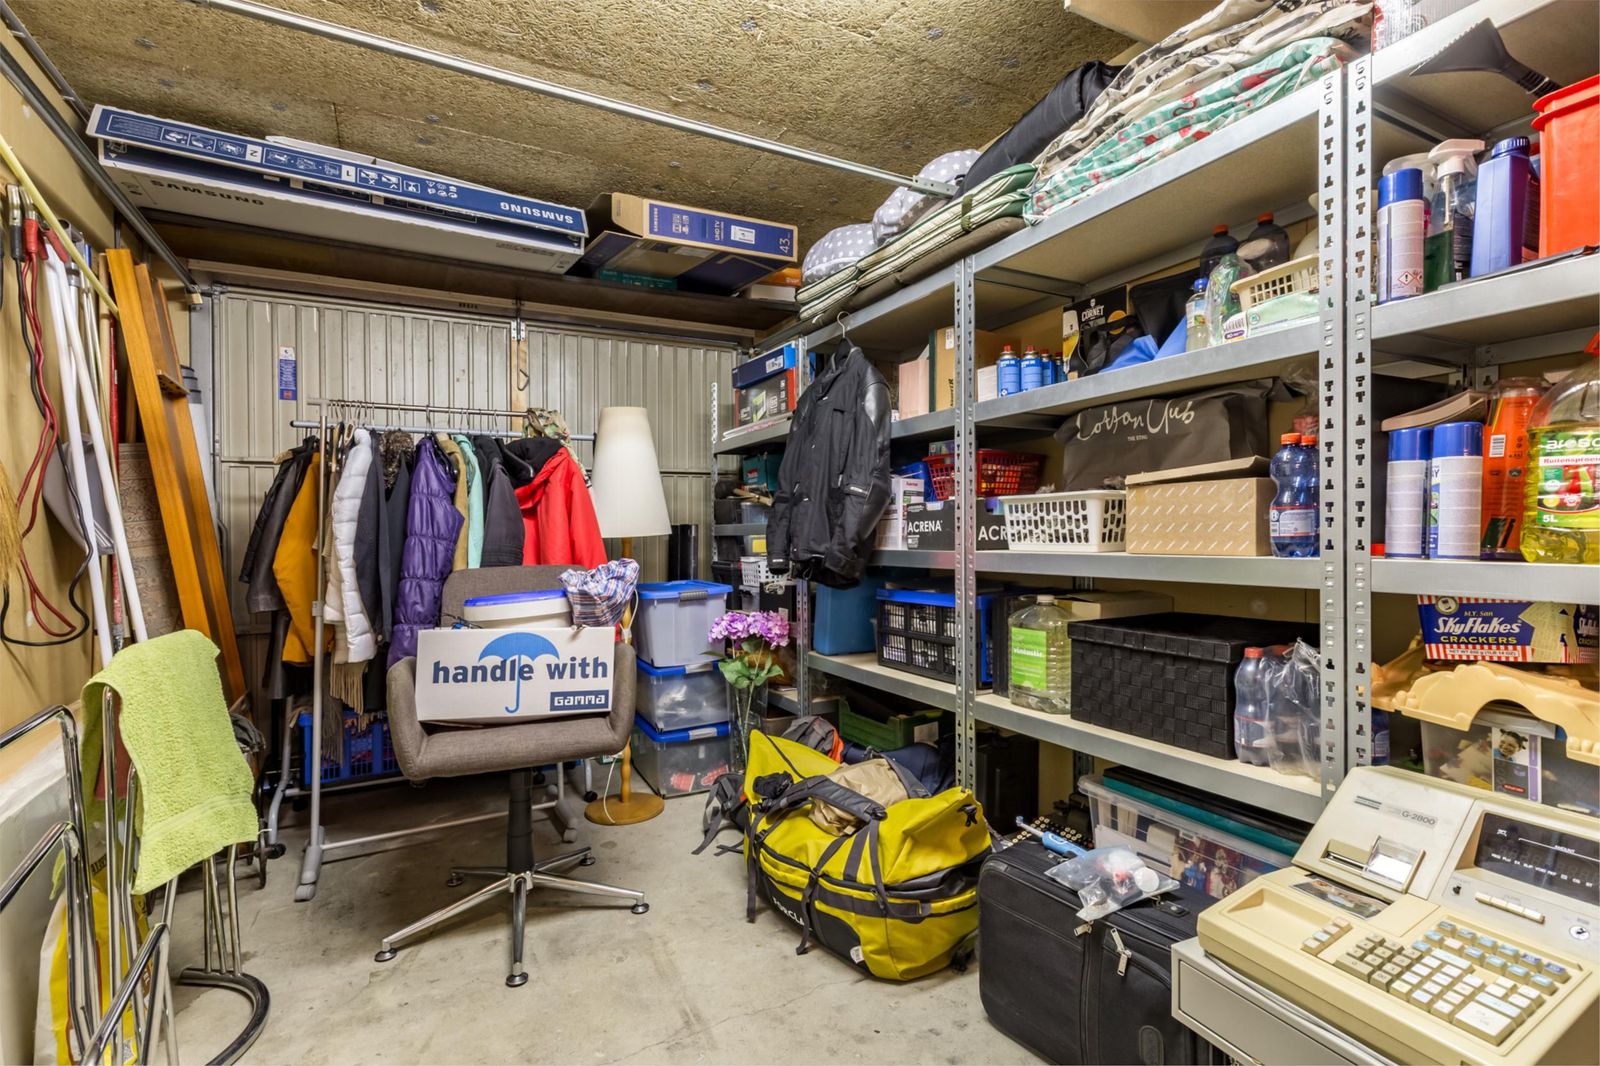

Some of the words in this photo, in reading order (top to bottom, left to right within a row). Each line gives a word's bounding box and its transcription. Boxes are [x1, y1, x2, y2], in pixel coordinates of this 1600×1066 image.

[151, 179, 264, 206] SAMSUNG
[500, 201, 574, 224] SAMSUNG
[779, 238, 790, 253] 43
[1081, 304, 1105, 322] CORNET
[1542, 514, 1558, 523] 5L
[908, 520, 942, 533] ACRENA
[978, 526, 1007, 541] ACR
[1434, 616, 1522, 635] SkyFlakes
[1440, 635, 1518, 644] CRACKERS
[432, 658, 534, 684] handle
[546, 656, 608, 680] with
[1401, 810, 1436, 825] G-2800
